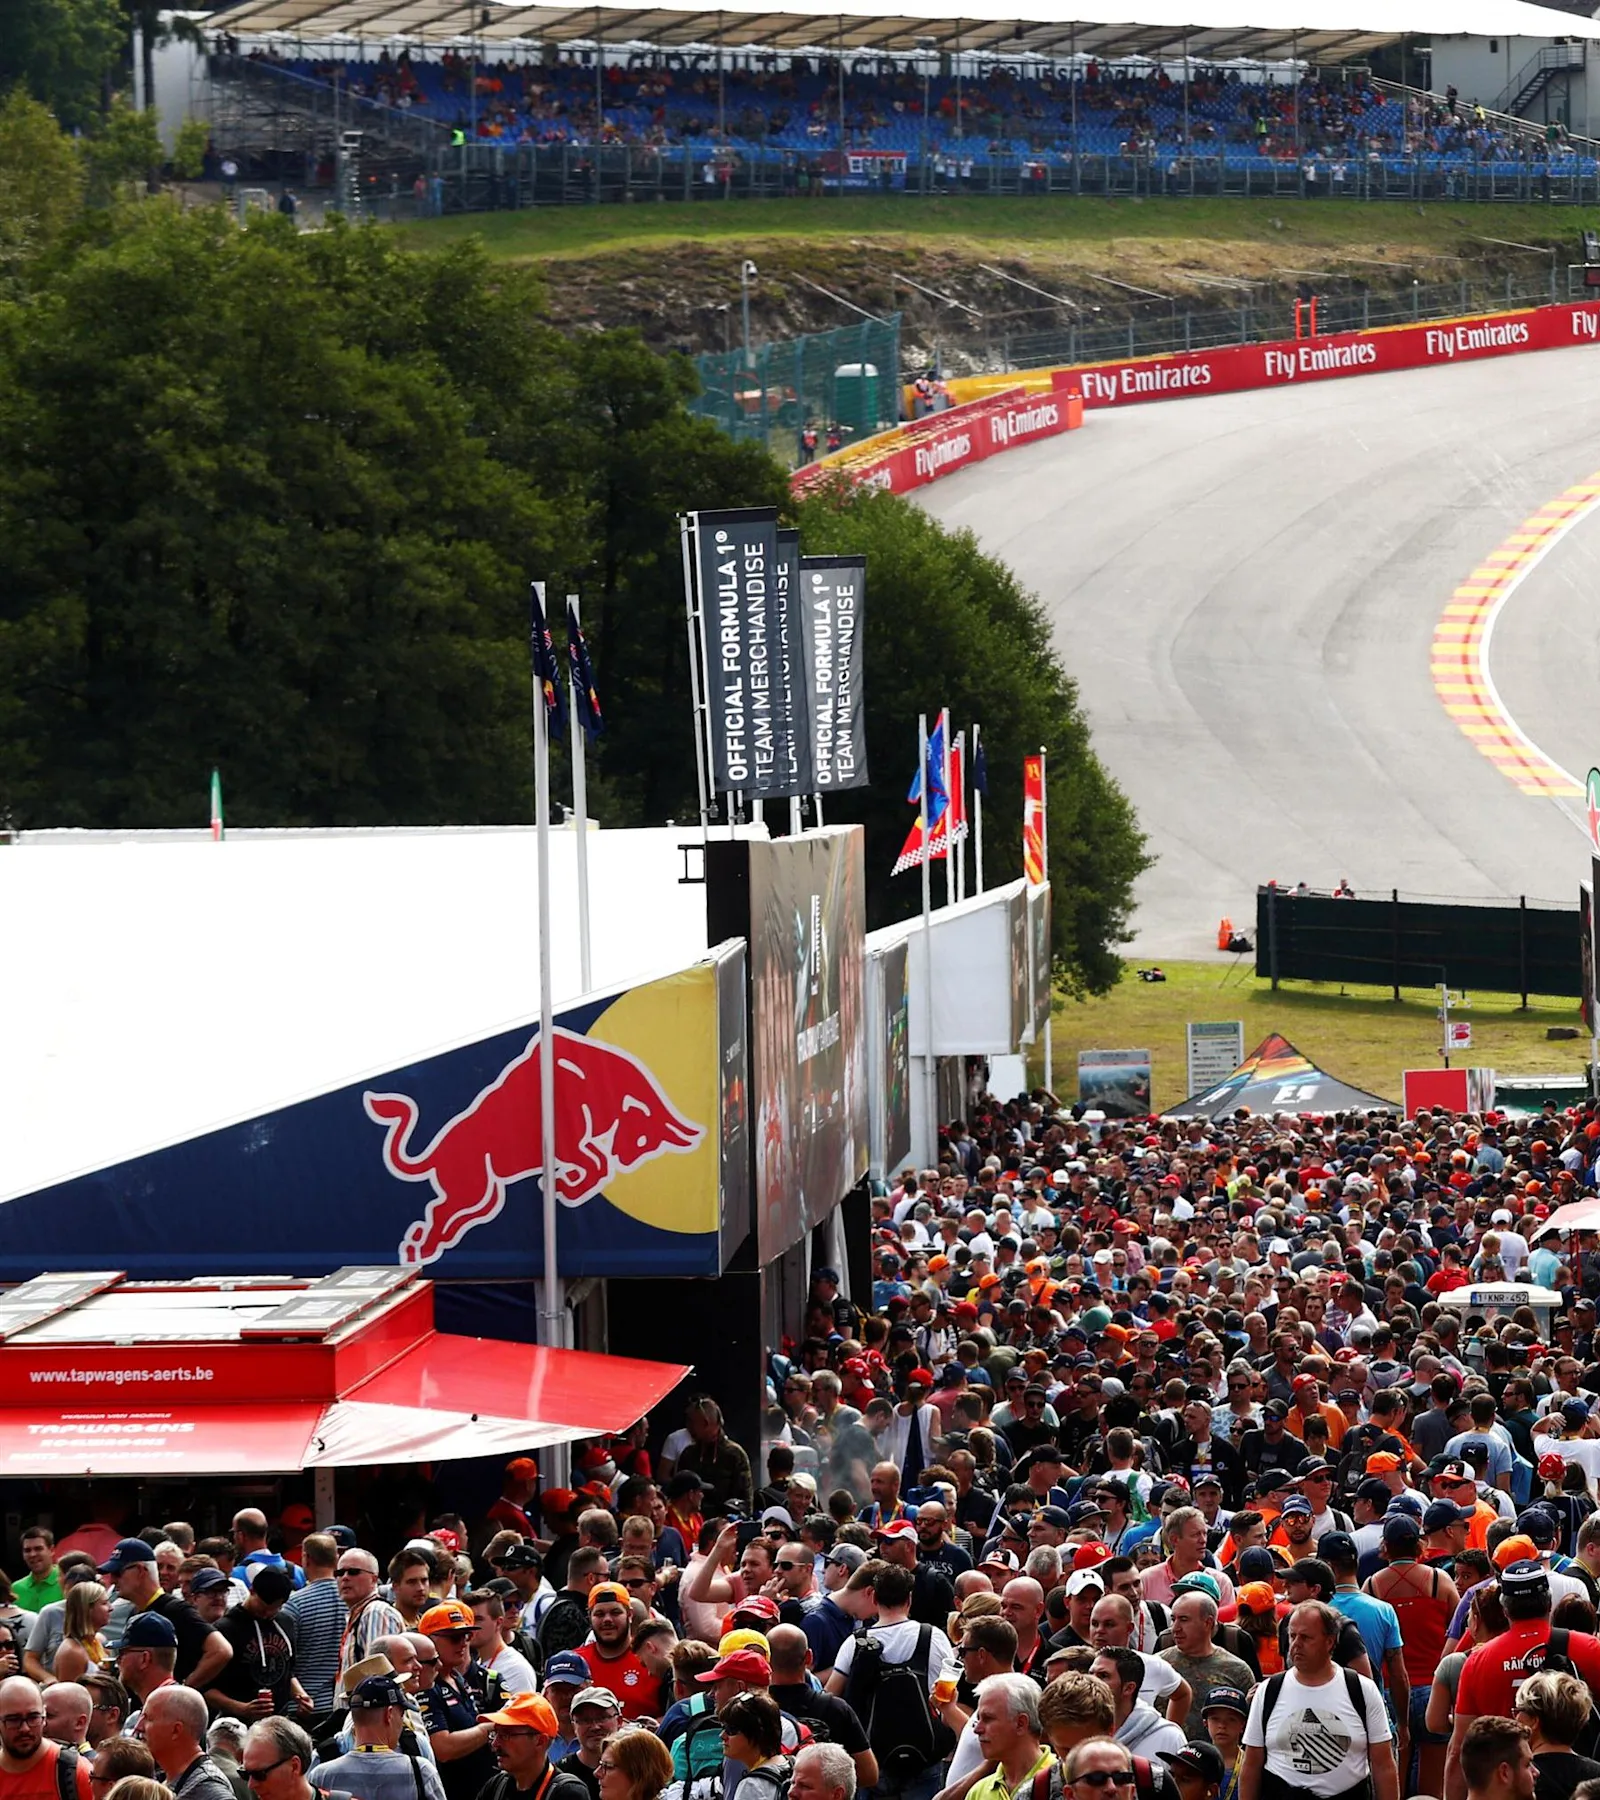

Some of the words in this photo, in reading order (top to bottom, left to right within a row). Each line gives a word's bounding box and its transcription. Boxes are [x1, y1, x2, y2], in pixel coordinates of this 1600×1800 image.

[1426, 330, 1454, 358] Fly
[1456, 321, 1528, 351] Emirates
[1572, 310, 1598, 338] Fly
[1080, 372, 1117, 401] Fly
[1121, 363, 1211, 394] Emirates
[1264, 350, 1296, 379] Fly
[1299, 342, 1376, 371] Emirates
[990, 414, 1009, 445] Fly
[1008, 403, 1059, 437] Emirates
[717, 559, 743, 673] FORMULA
[743, 541, 772, 711] MERCHANDISE
[813, 598, 833, 694] FORMULA
[836, 584, 855, 726] MERCHANDISE
[724, 677, 749, 781] OFFICIAL
[752, 715, 775, 780] TEAM
[816, 697, 834, 785] OFFICIAL
[836, 728, 856, 783] TEAM
[30, 1366, 214, 1385] www.tapwagens-aerts.be
[27, 1423, 196, 1434] TAPWAGENS
